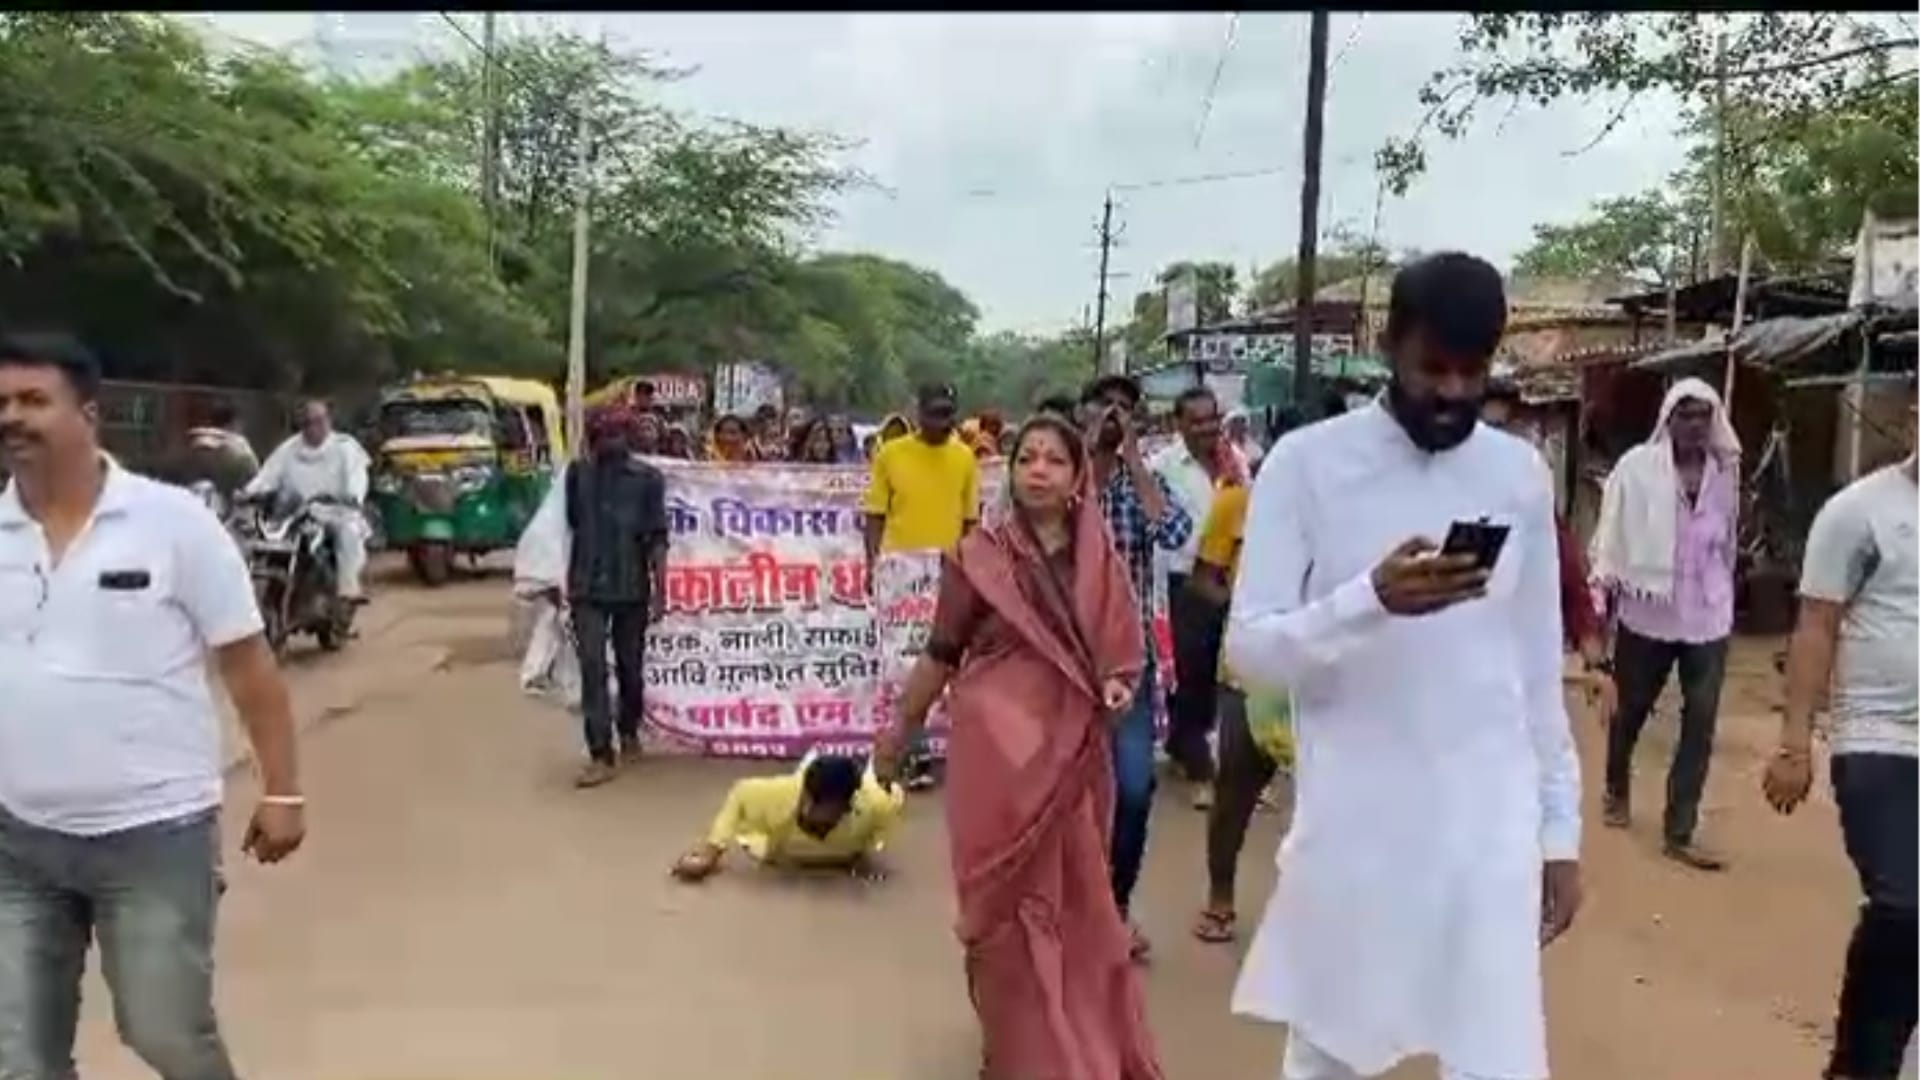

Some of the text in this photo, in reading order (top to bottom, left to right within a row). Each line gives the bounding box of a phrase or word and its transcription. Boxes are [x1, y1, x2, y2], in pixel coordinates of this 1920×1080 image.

[711, 496, 840, 537] विकास
[830, 560, 867, 609] ध
[804, 619, 876, 647] सफाई
[648, 659, 708, 686] आदि
[717, 663, 804, 691] मूलभूत
